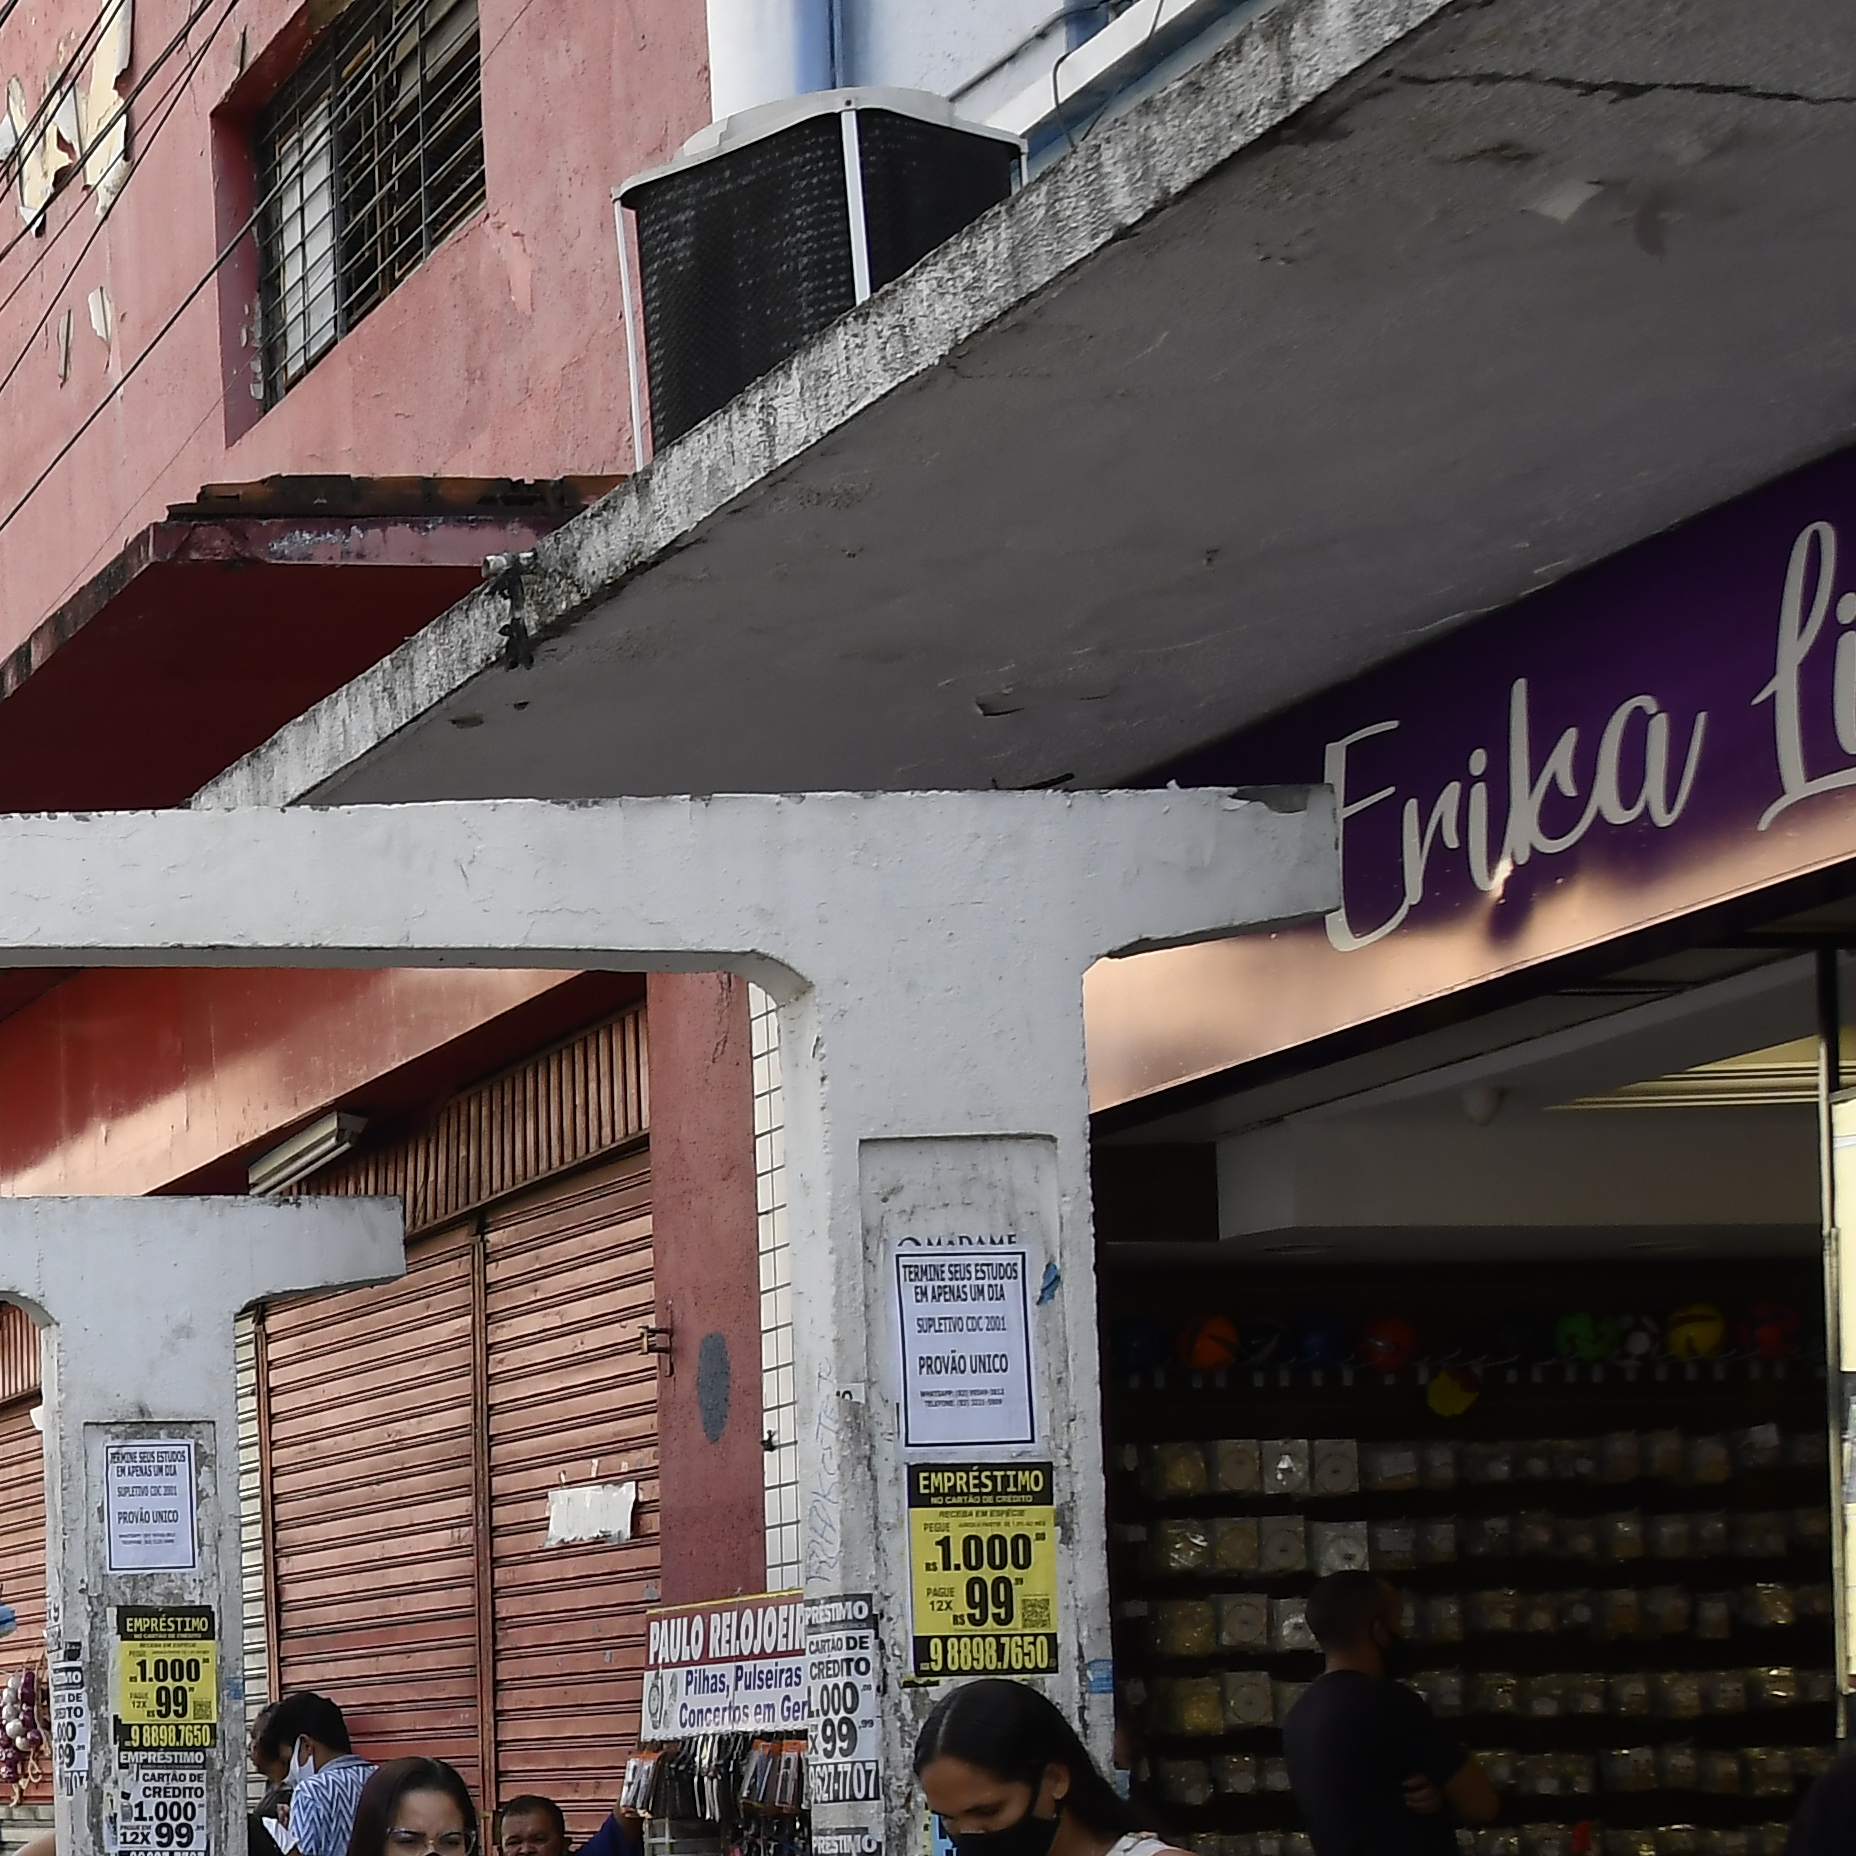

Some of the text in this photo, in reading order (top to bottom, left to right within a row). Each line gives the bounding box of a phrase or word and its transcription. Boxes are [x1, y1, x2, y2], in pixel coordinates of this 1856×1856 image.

[1324, 677, 1708, 953] Erika
[902, 1262, 1018, 1282] TERMINE SEUS ESTUDOS
[914, 1284, 1006, 1303] EM APENAS UM DIA
[916, 1316, 1007, 1334] SUPLETIVO CDC 2001
[918, 1349, 1009, 1376] PROVÃO UNICO
[918, 1466, 1044, 1494] EMPRÉSTIMO
[117, 1507, 179, 1524] PROVÃO UNICO
[935, 1533, 1032, 1572] 1.000
[929, 1600, 953, 1612] 12X
[965, 1576, 1015, 1628] 99
[126, 1613, 209, 1632] EMPRÉSTIMO
[649, 1614, 705, 1665] PAULO
[808, 1635, 870, 1656] CARTÃO DE
[929, 1635, 1049, 1672] 9 8898.7650
[136, 1658, 201, 1683] 1.000
[685, 1662, 803, 1699] Pilhas, Pulseiras
[809, 1655, 871, 1681] CRÉDITO
[156, 1685, 188, 1719] 99
[679, 1702, 750, 1730] Concertos
[754, 1708, 776, 1724] em
[821, 1716, 858, 1759] 99
[120, 1748, 205, 1763] EMPRÉSTIMO
[142, 1771, 205, 1783] CARTÃO DE
[133, 1801, 197, 1822] 1.000
[119, 1822, 194, 1848] 12X 99
